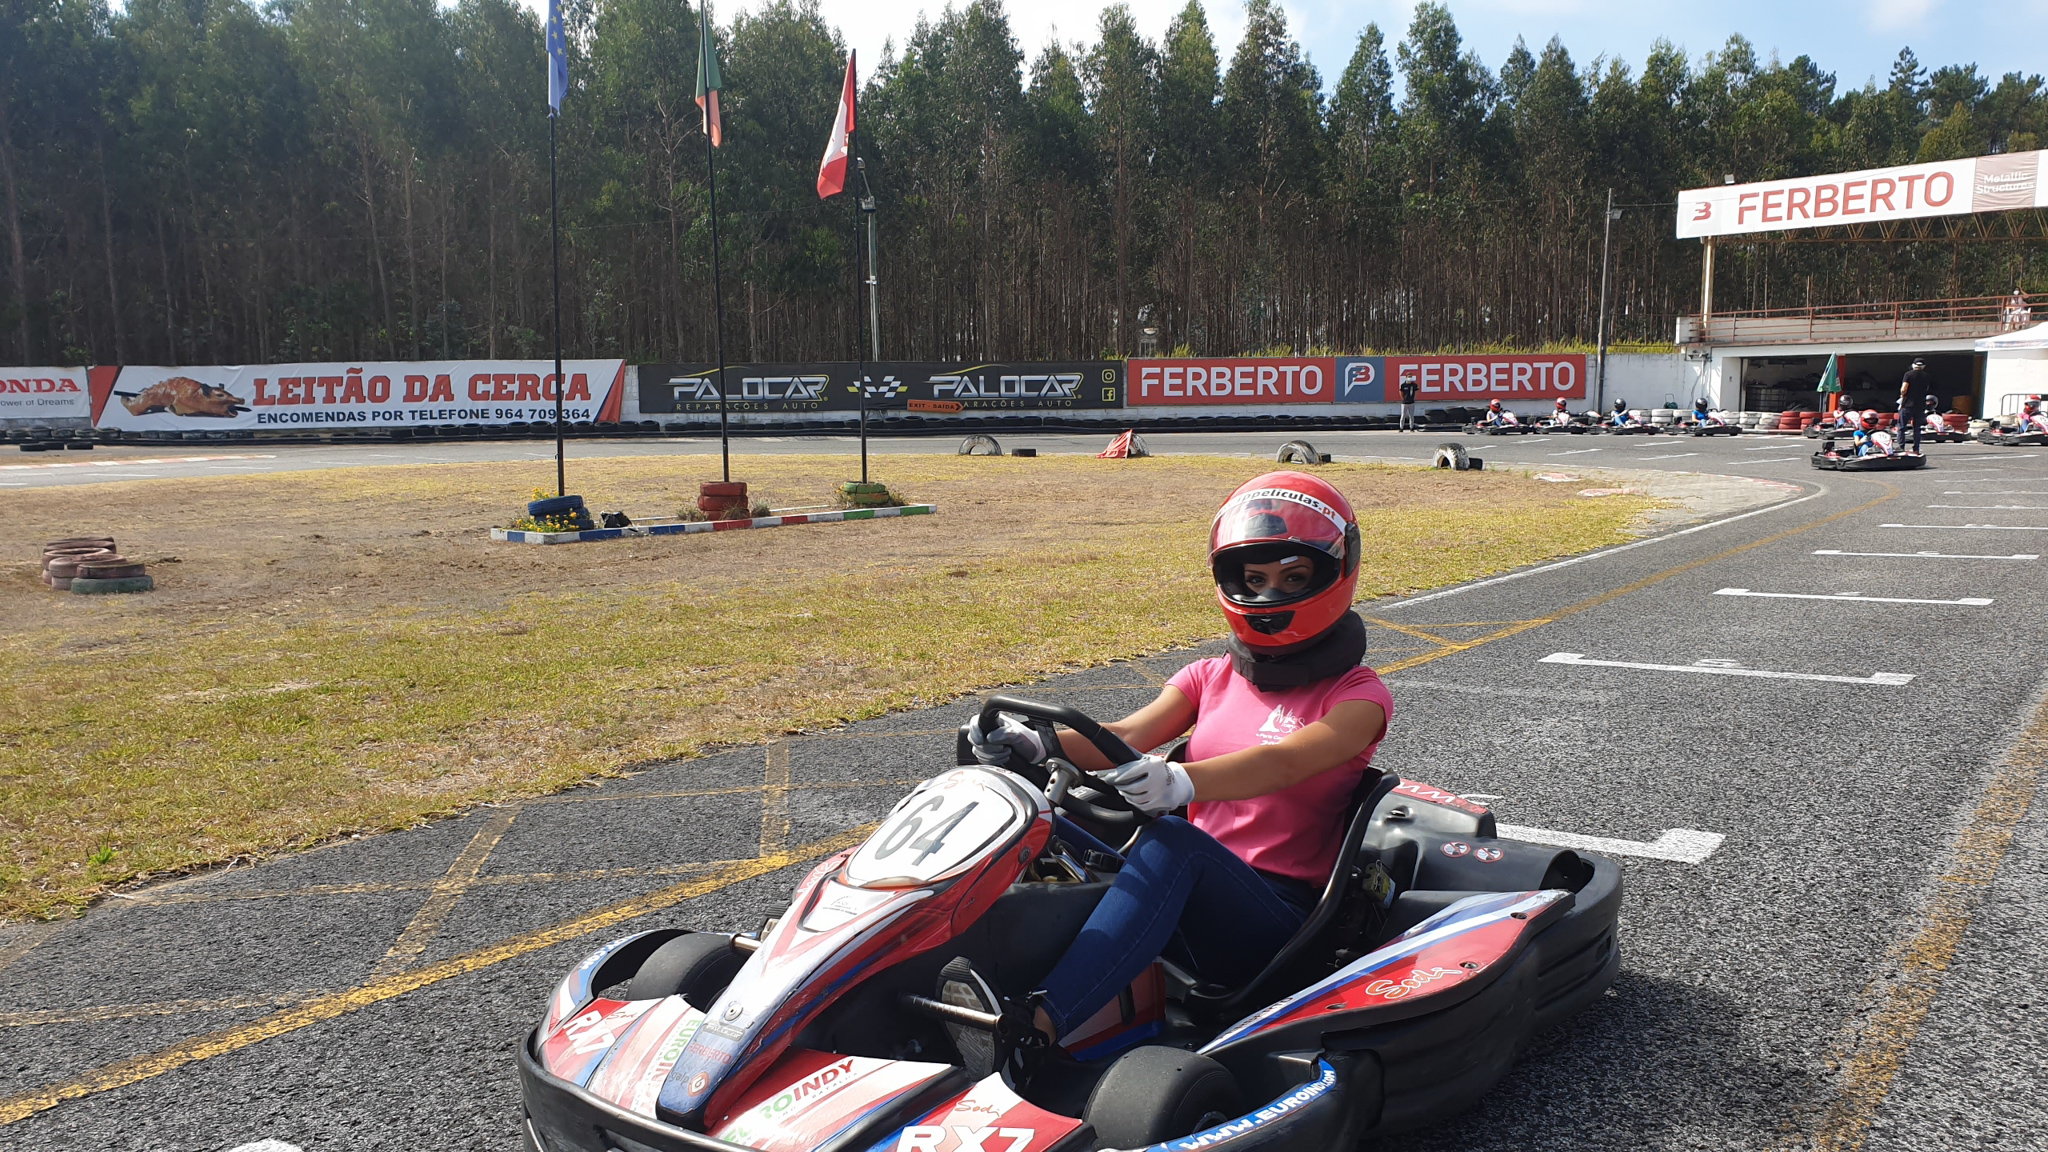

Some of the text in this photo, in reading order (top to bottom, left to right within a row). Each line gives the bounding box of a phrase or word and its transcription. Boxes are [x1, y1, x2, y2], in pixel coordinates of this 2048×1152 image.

[1983, 171, 2030, 184] Metallic
[1737, 171, 1955, 225] FERBERTO
[252, 366, 592, 406] LEITÃO DA CERCA
[928, 374, 1083, 399] PALOCAR
[1141, 365, 1323, 397] FERBERTO
[1399, 361, 1576, 394] FERBERTO
[0, 398, 22, 406] ower
[37, 398, 75, 406] Dreams
[676, 401, 818, 412] REPARAÇÕES AUTO
[963, 400, 1073, 410] ARAÇÕES AUTO
[257, 408, 590, 424] ENCOMENDAS POR TELEFONE 964 709 364
[873, 795, 980, 866] 64
[687, 1042, 732, 1065] FERBERTO
[954, 1099, 1001, 1118] Sodi
[1178, 1069, 1336, 1151] WWW.EUROINDY.COM
[895, 1125, 1035, 1152] RX7
